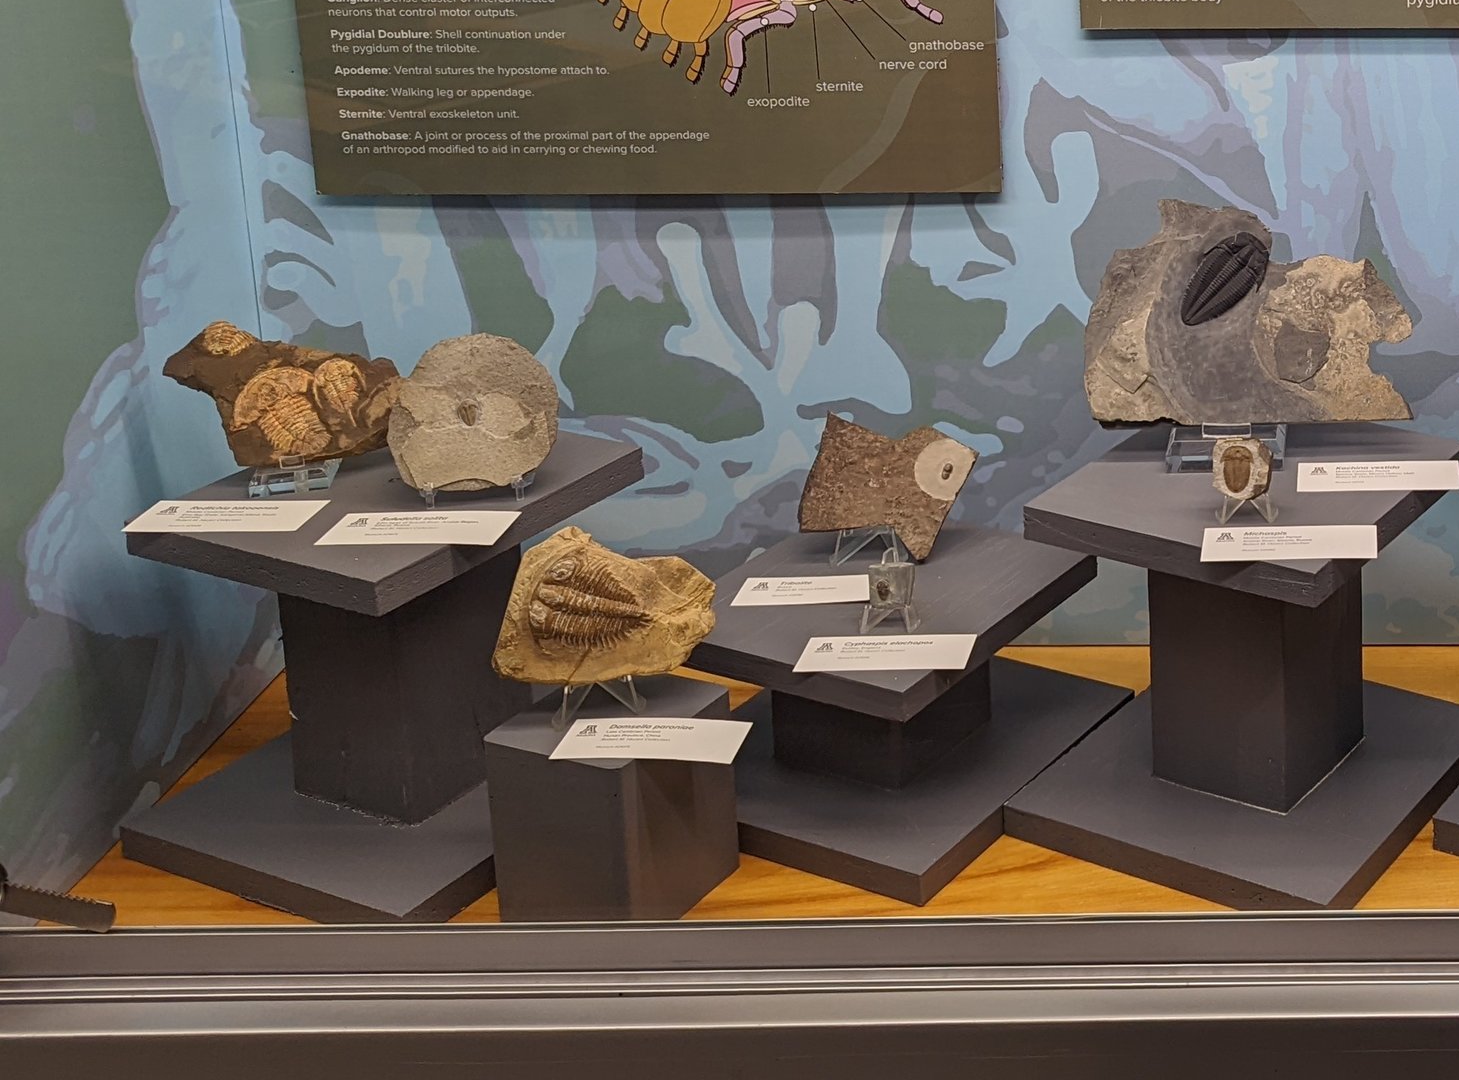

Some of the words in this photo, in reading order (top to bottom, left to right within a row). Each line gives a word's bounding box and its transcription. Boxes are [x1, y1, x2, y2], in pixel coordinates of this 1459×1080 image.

[909, 40, 984, 53] gnathobase
[880, 61, 915, 69] nerve
[919, 59, 946, 69] cord
[816, 81, 863, 91] sternite
[748, 96, 809, 109] exopodite
